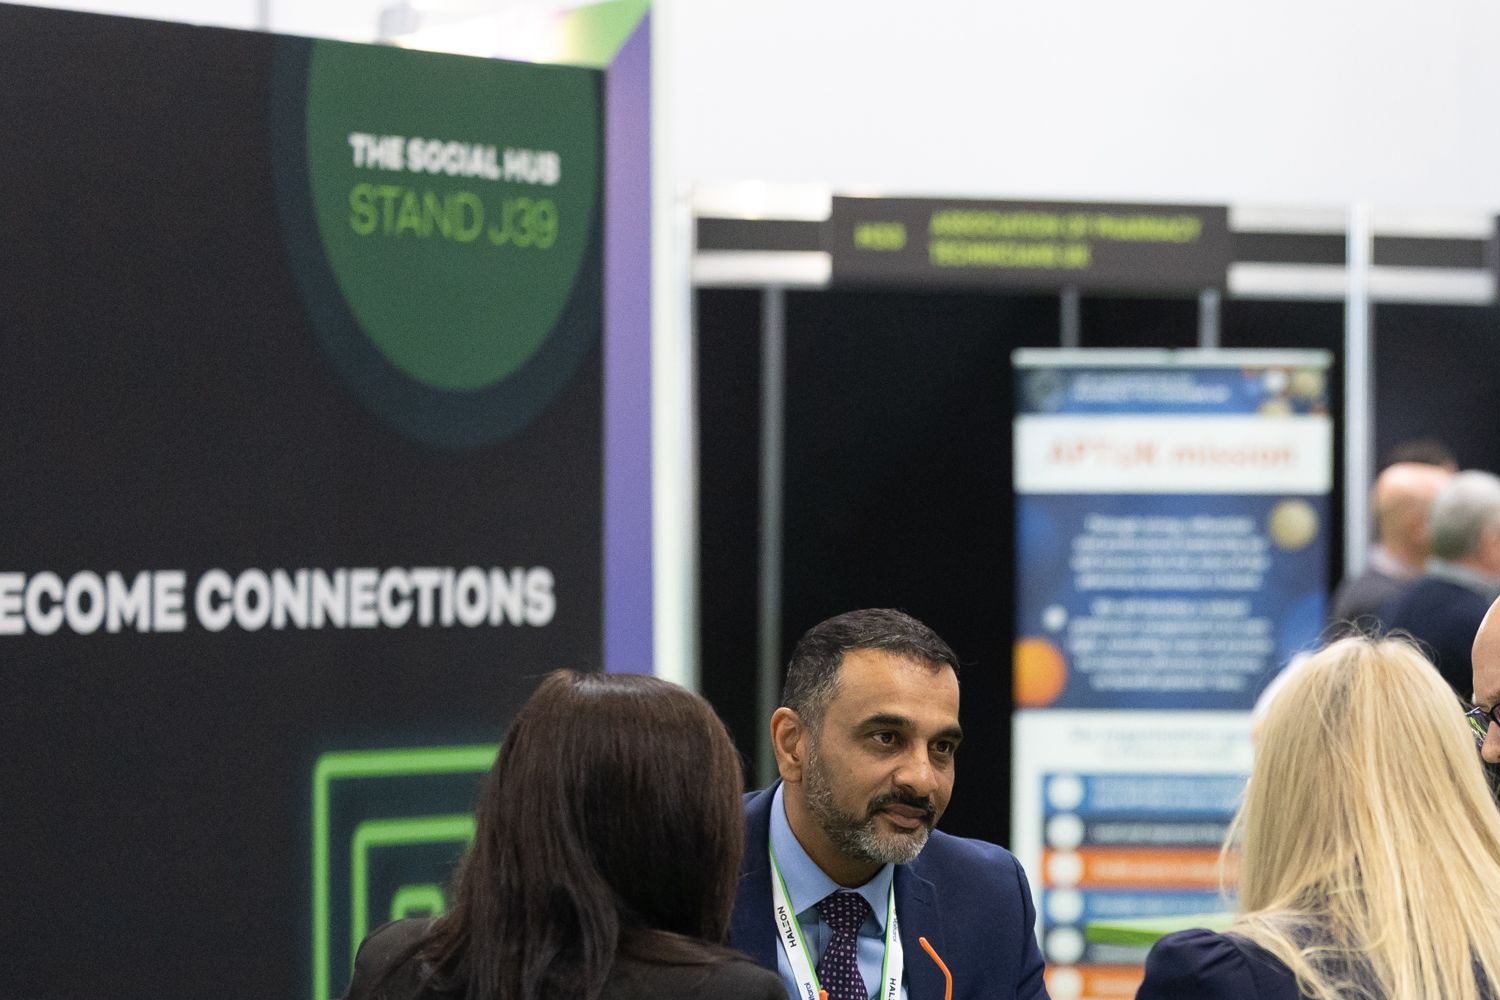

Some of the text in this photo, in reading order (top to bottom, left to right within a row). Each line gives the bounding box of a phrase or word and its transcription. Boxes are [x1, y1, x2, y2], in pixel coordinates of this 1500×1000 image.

[349, 132, 561, 186] THE SOCIAL HUB
[350, 183, 559, 249] STAND J39
[195, 566, 557, 632] CONNECTIONS
[777, 905, 797, 948] HALEON
